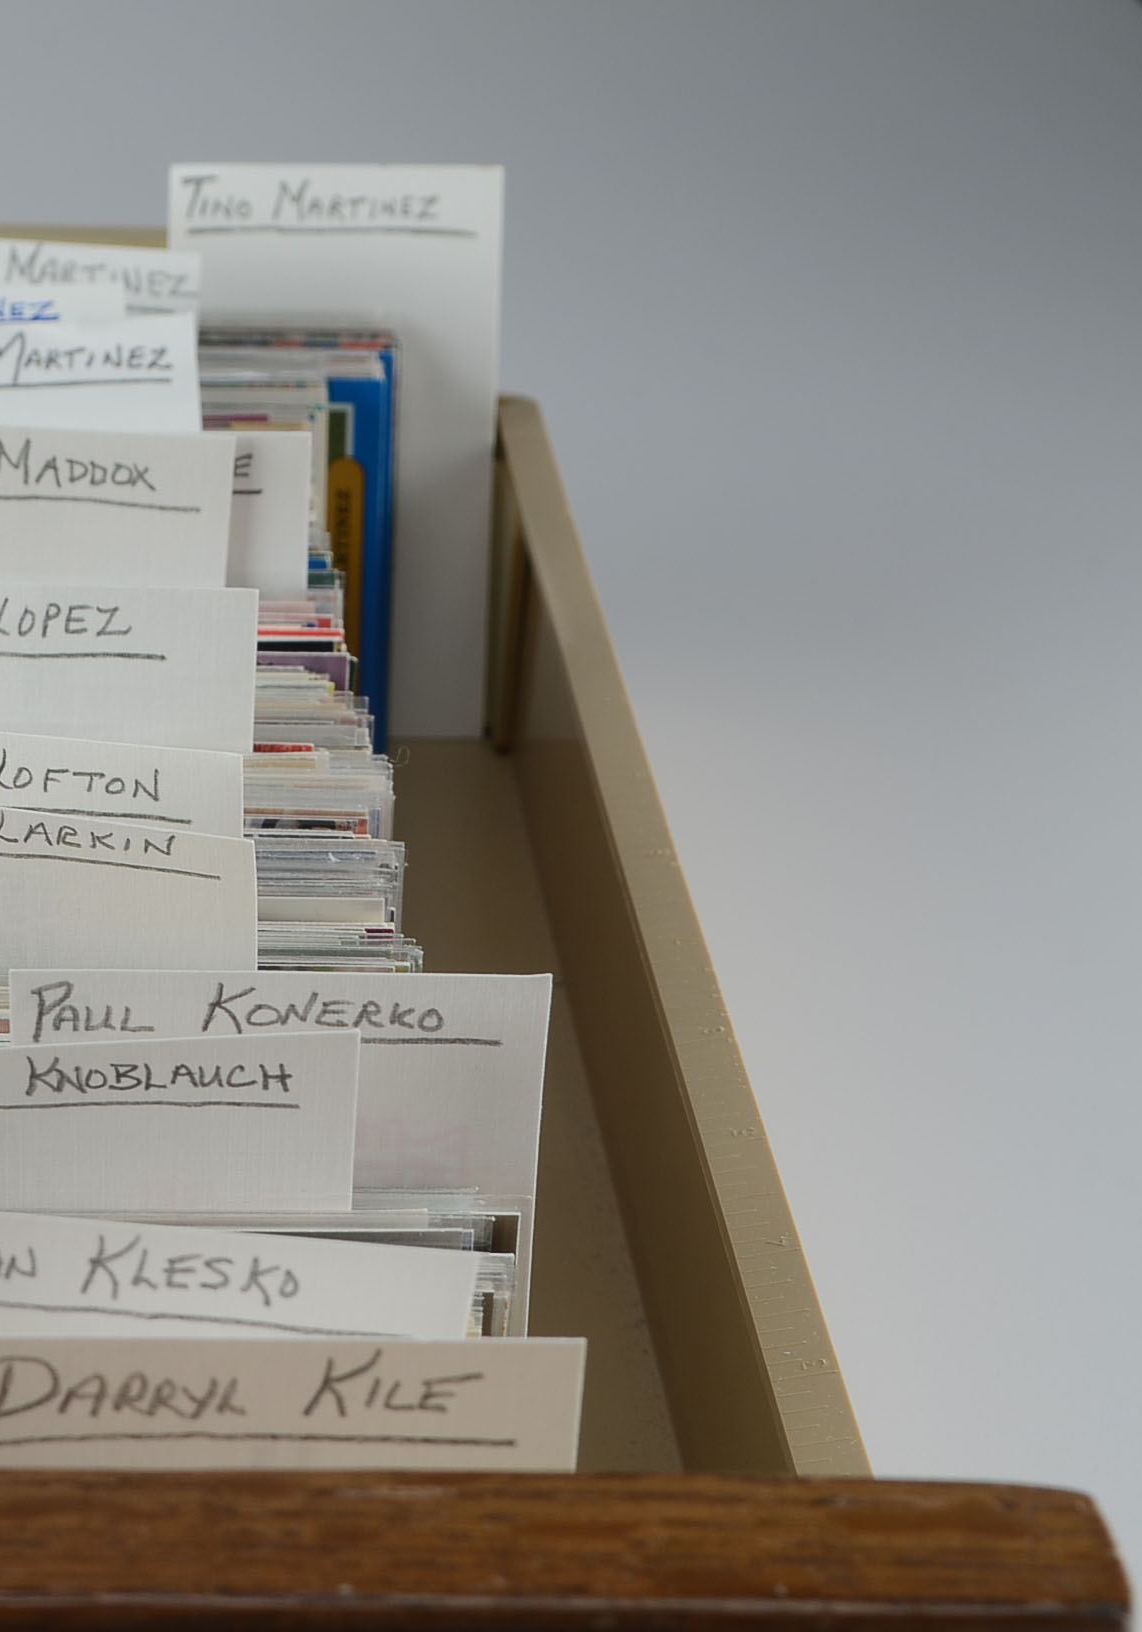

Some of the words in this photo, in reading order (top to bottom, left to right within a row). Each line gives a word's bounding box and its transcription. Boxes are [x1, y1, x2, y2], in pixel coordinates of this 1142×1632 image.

[180, 173, 253, 222] TINO
[272, 180, 440, 220] MARTINEZ
[7, 242, 199, 298] MARTINEZ
[30, 980, 155, 1042] PAUL
[202, 982, 446, 1035] KONERKO
[25, 1056, 294, 1096] KNOBLAUCH
[80, 1234, 300, 1307] KLESKO
[303, 1348, 485, 1418] KILE
